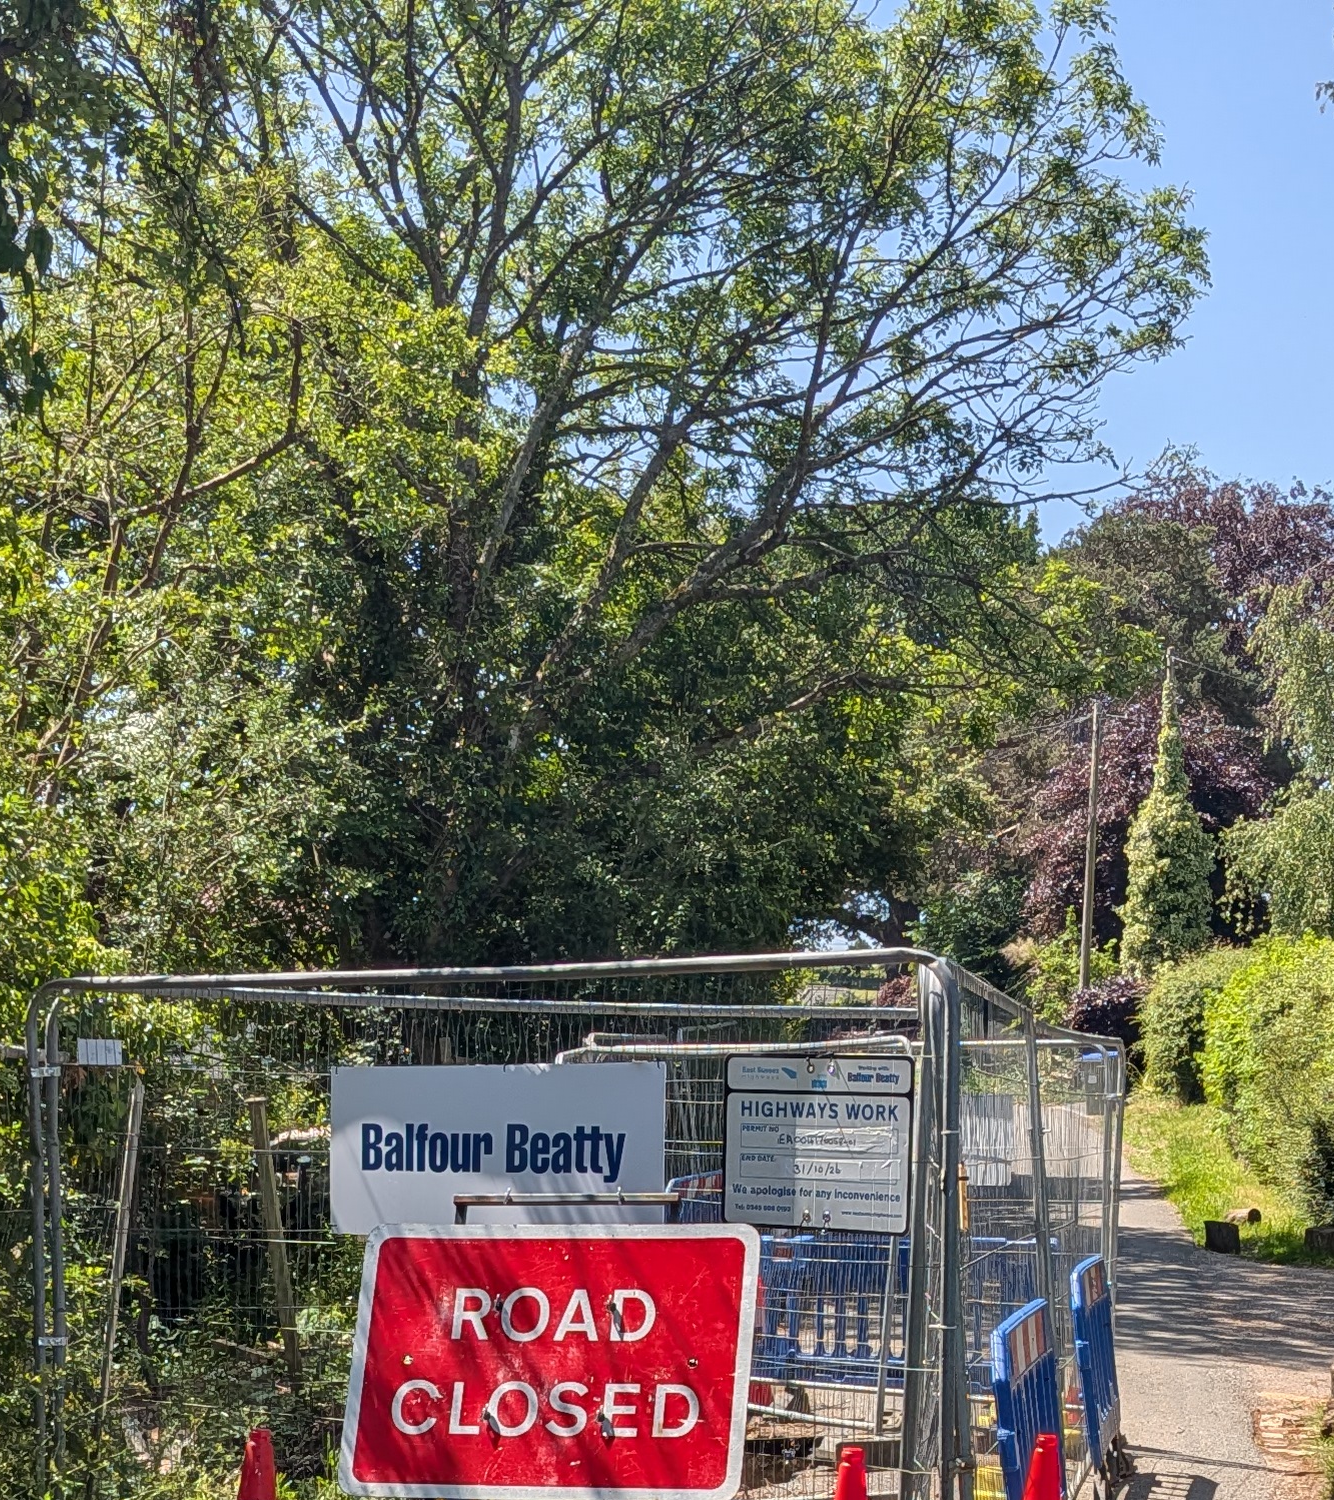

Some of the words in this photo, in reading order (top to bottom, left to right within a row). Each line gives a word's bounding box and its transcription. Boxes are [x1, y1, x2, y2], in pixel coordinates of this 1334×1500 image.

[847, 1072, 874, 1083] Balfour
[875, 1073, 900, 1085] Beatty
[741, 1100, 839, 1119] HIGHWAYS
[845, 1103, 899, 1121] WORK
[361, 1123, 493, 1172] Balfour
[505, 1123, 626, 1183] Beatty
[732, 1184, 748, 1194] We
[750, 1185, 796, 1197] apologise
[799, 1187, 813, 1197] for
[815, 1190, 831, 1200] any
[834, 1190, 900, 1202] inconvenience
[450, 1287, 657, 1343] ROAD
[391, 1379, 700, 1438] CLOSED
